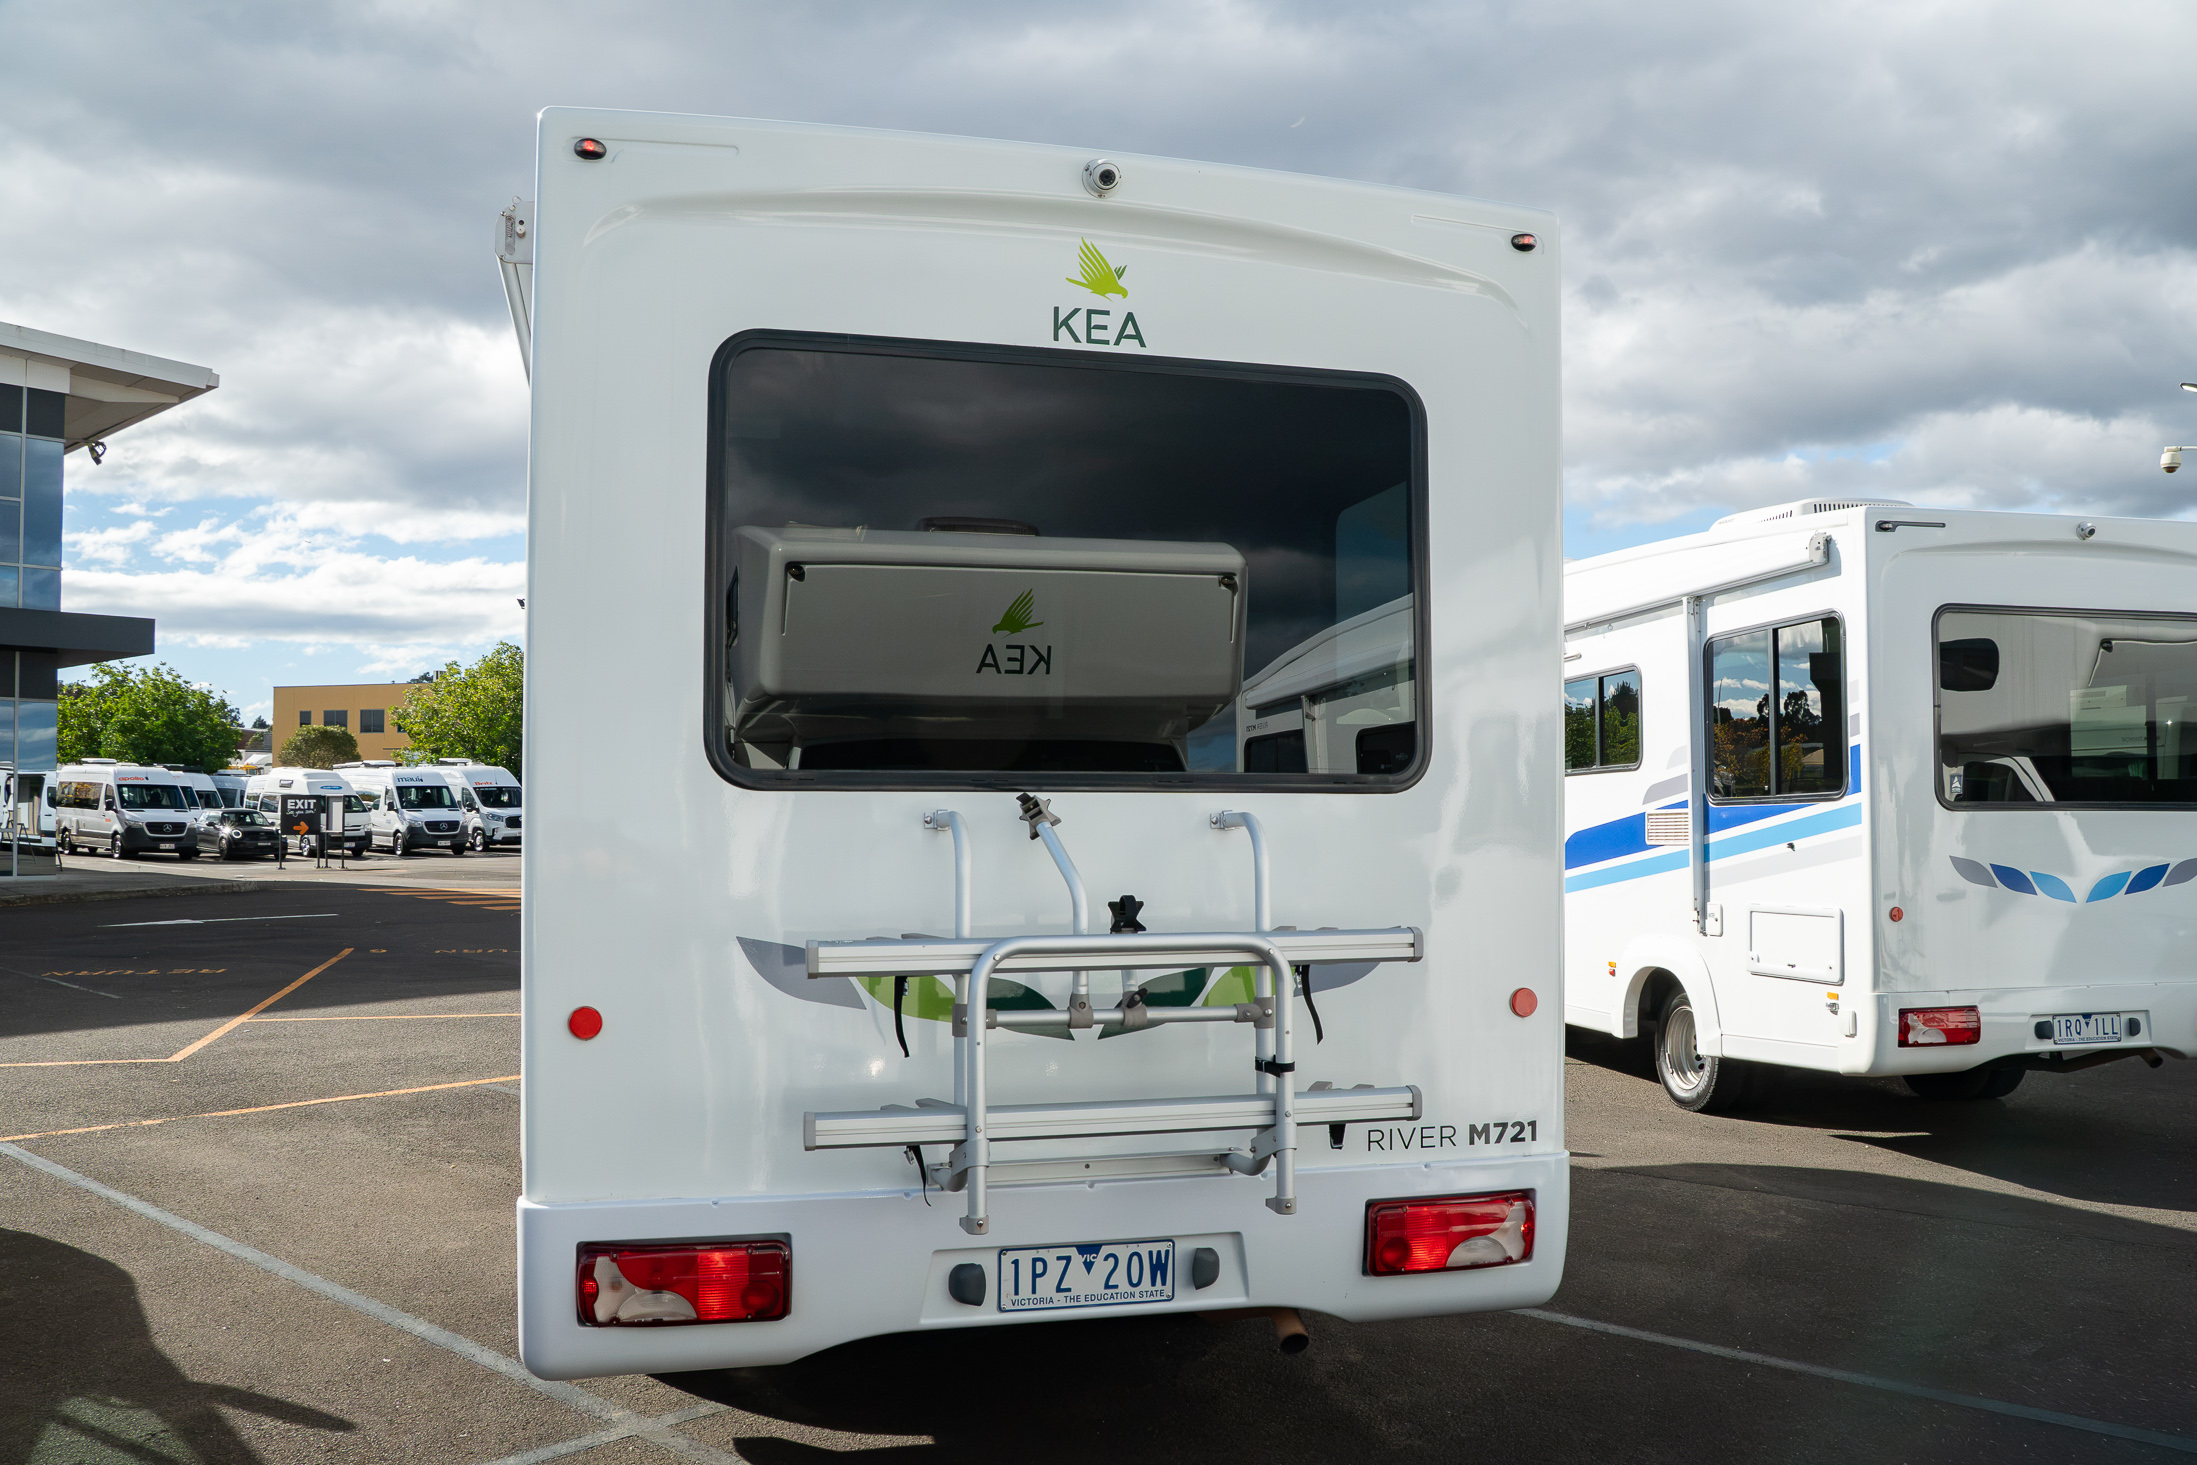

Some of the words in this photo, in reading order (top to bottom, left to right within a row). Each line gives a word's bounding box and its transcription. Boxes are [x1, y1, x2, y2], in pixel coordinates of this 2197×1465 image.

[1053, 305, 1147, 348] KEA
[287, 799, 317, 809] EXIT
[2057, 1018, 2082, 1037] 1RQ
[2095, 1017, 2118, 1036] 1LL
[1367, 1125, 1457, 1151] RIVER
[1469, 1120, 1537, 1146] M721
[1079, 1253, 1098, 1262] VIC
[1011, 1255, 1072, 1296] 1PZ
[1011, 1296, 1054, 1306] VICTORIA
[1064, 1294, 1081, 1303] THE
[1084, 1291, 1136, 1302] EDUCATION
[1138, 1289, 1165, 1298] STATE
